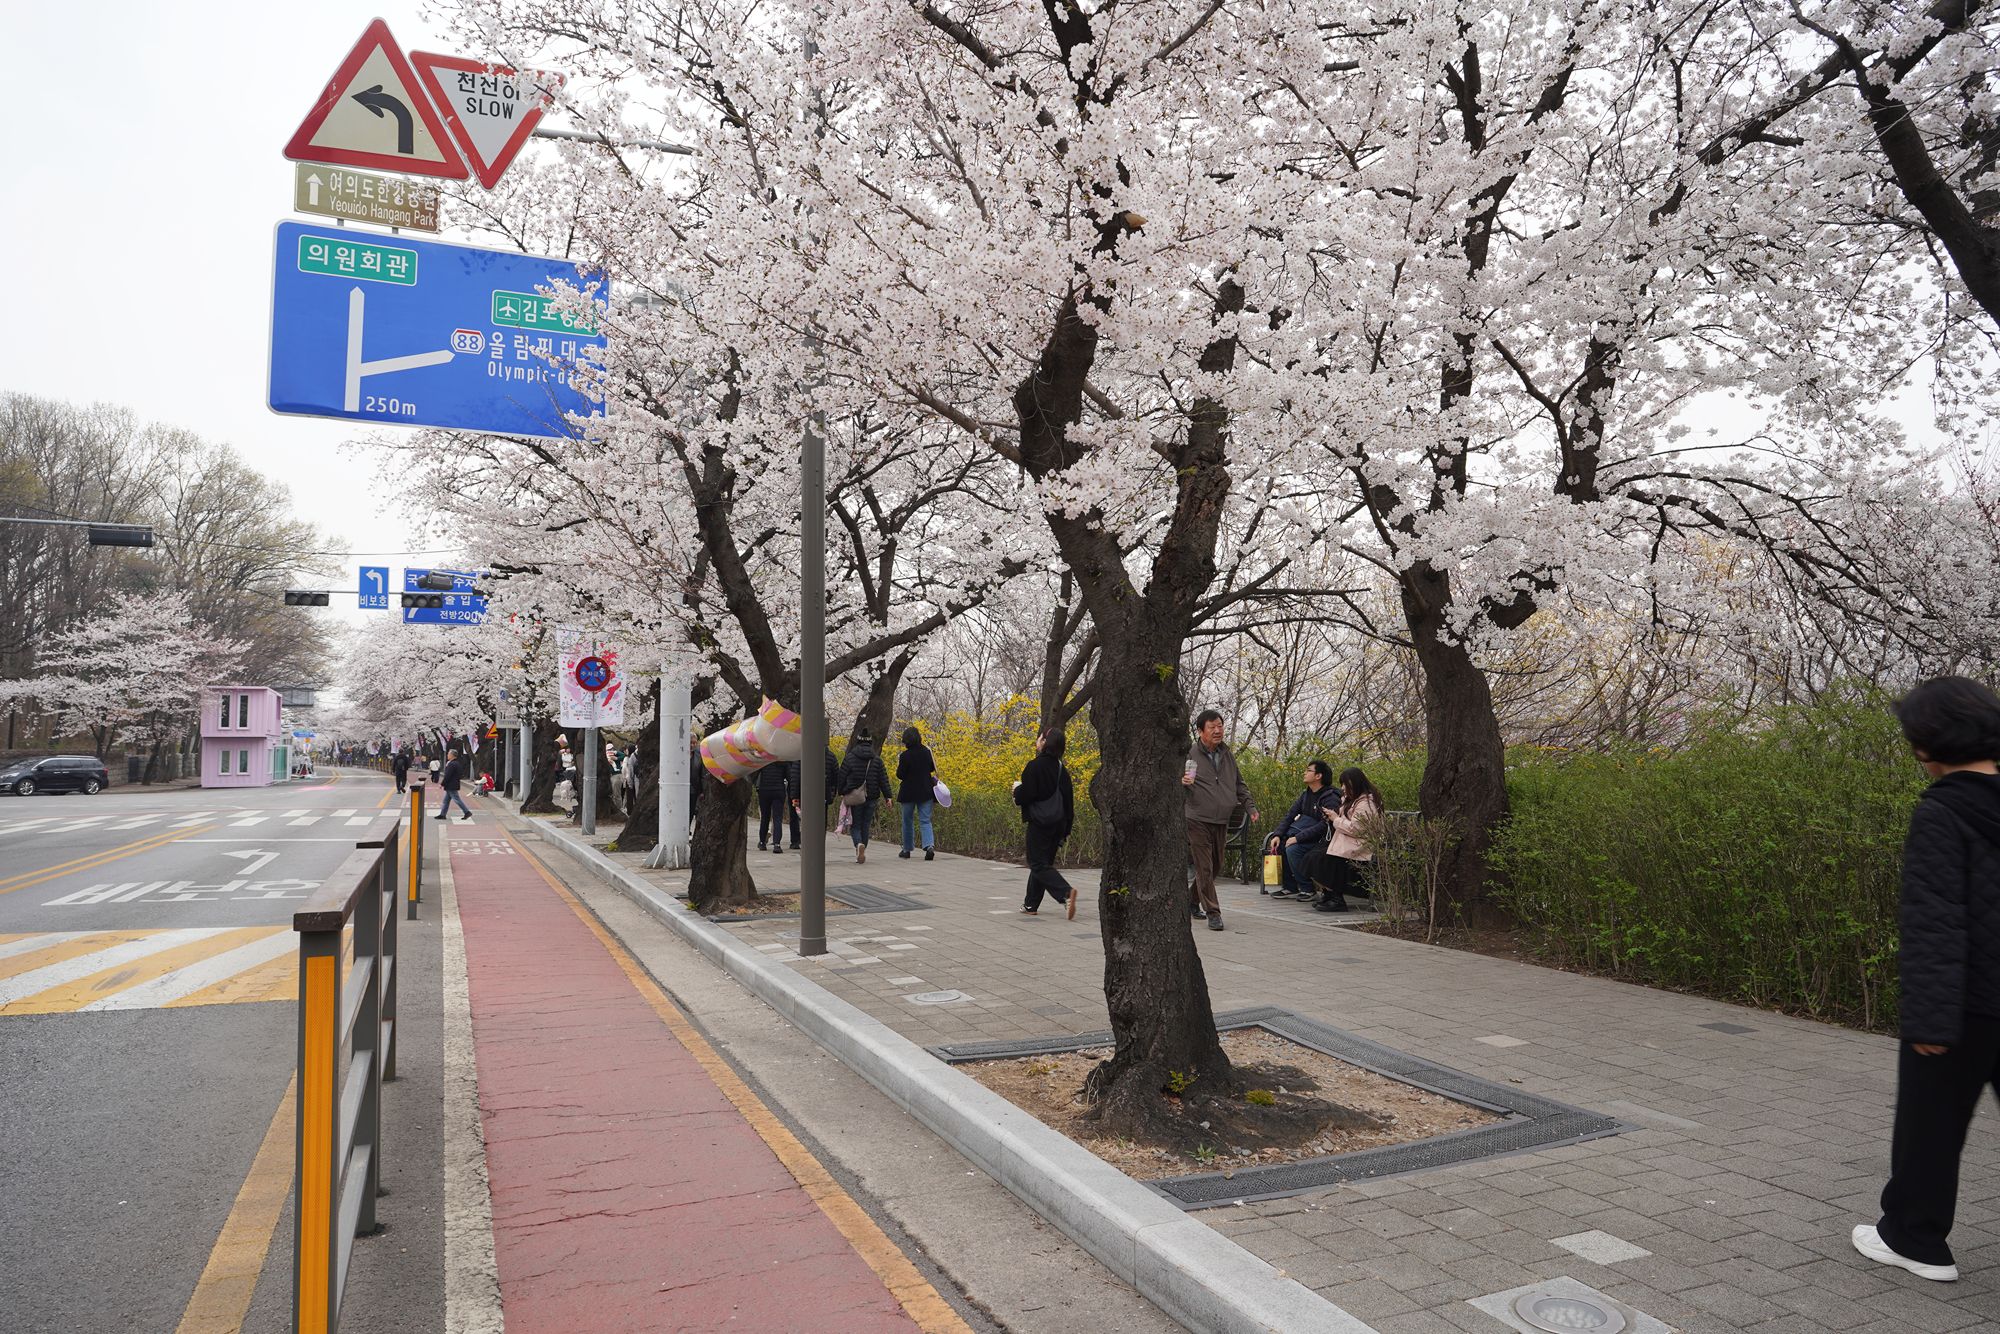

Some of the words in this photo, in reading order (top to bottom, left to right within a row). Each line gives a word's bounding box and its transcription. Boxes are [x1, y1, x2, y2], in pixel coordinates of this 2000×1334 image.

[457, 72, 520, 101] 천천히
[466, 97, 514, 120] SLOW
[329, 195, 368, 216] Yeouido
[370, 202, 411, 226] Hangang
[413, 210, 434, 227] Park
[307, 243, 409, 279] 의원회관
[522, 300, 595, 330] 김포
[457, 334, 479, 350] 88
[365, 396, 416, 416] 250m
[360, 595, 387, 607] 비보호
[439, 610, 487, 622] 전방200
[41, 879, 326, 906] 비보호
